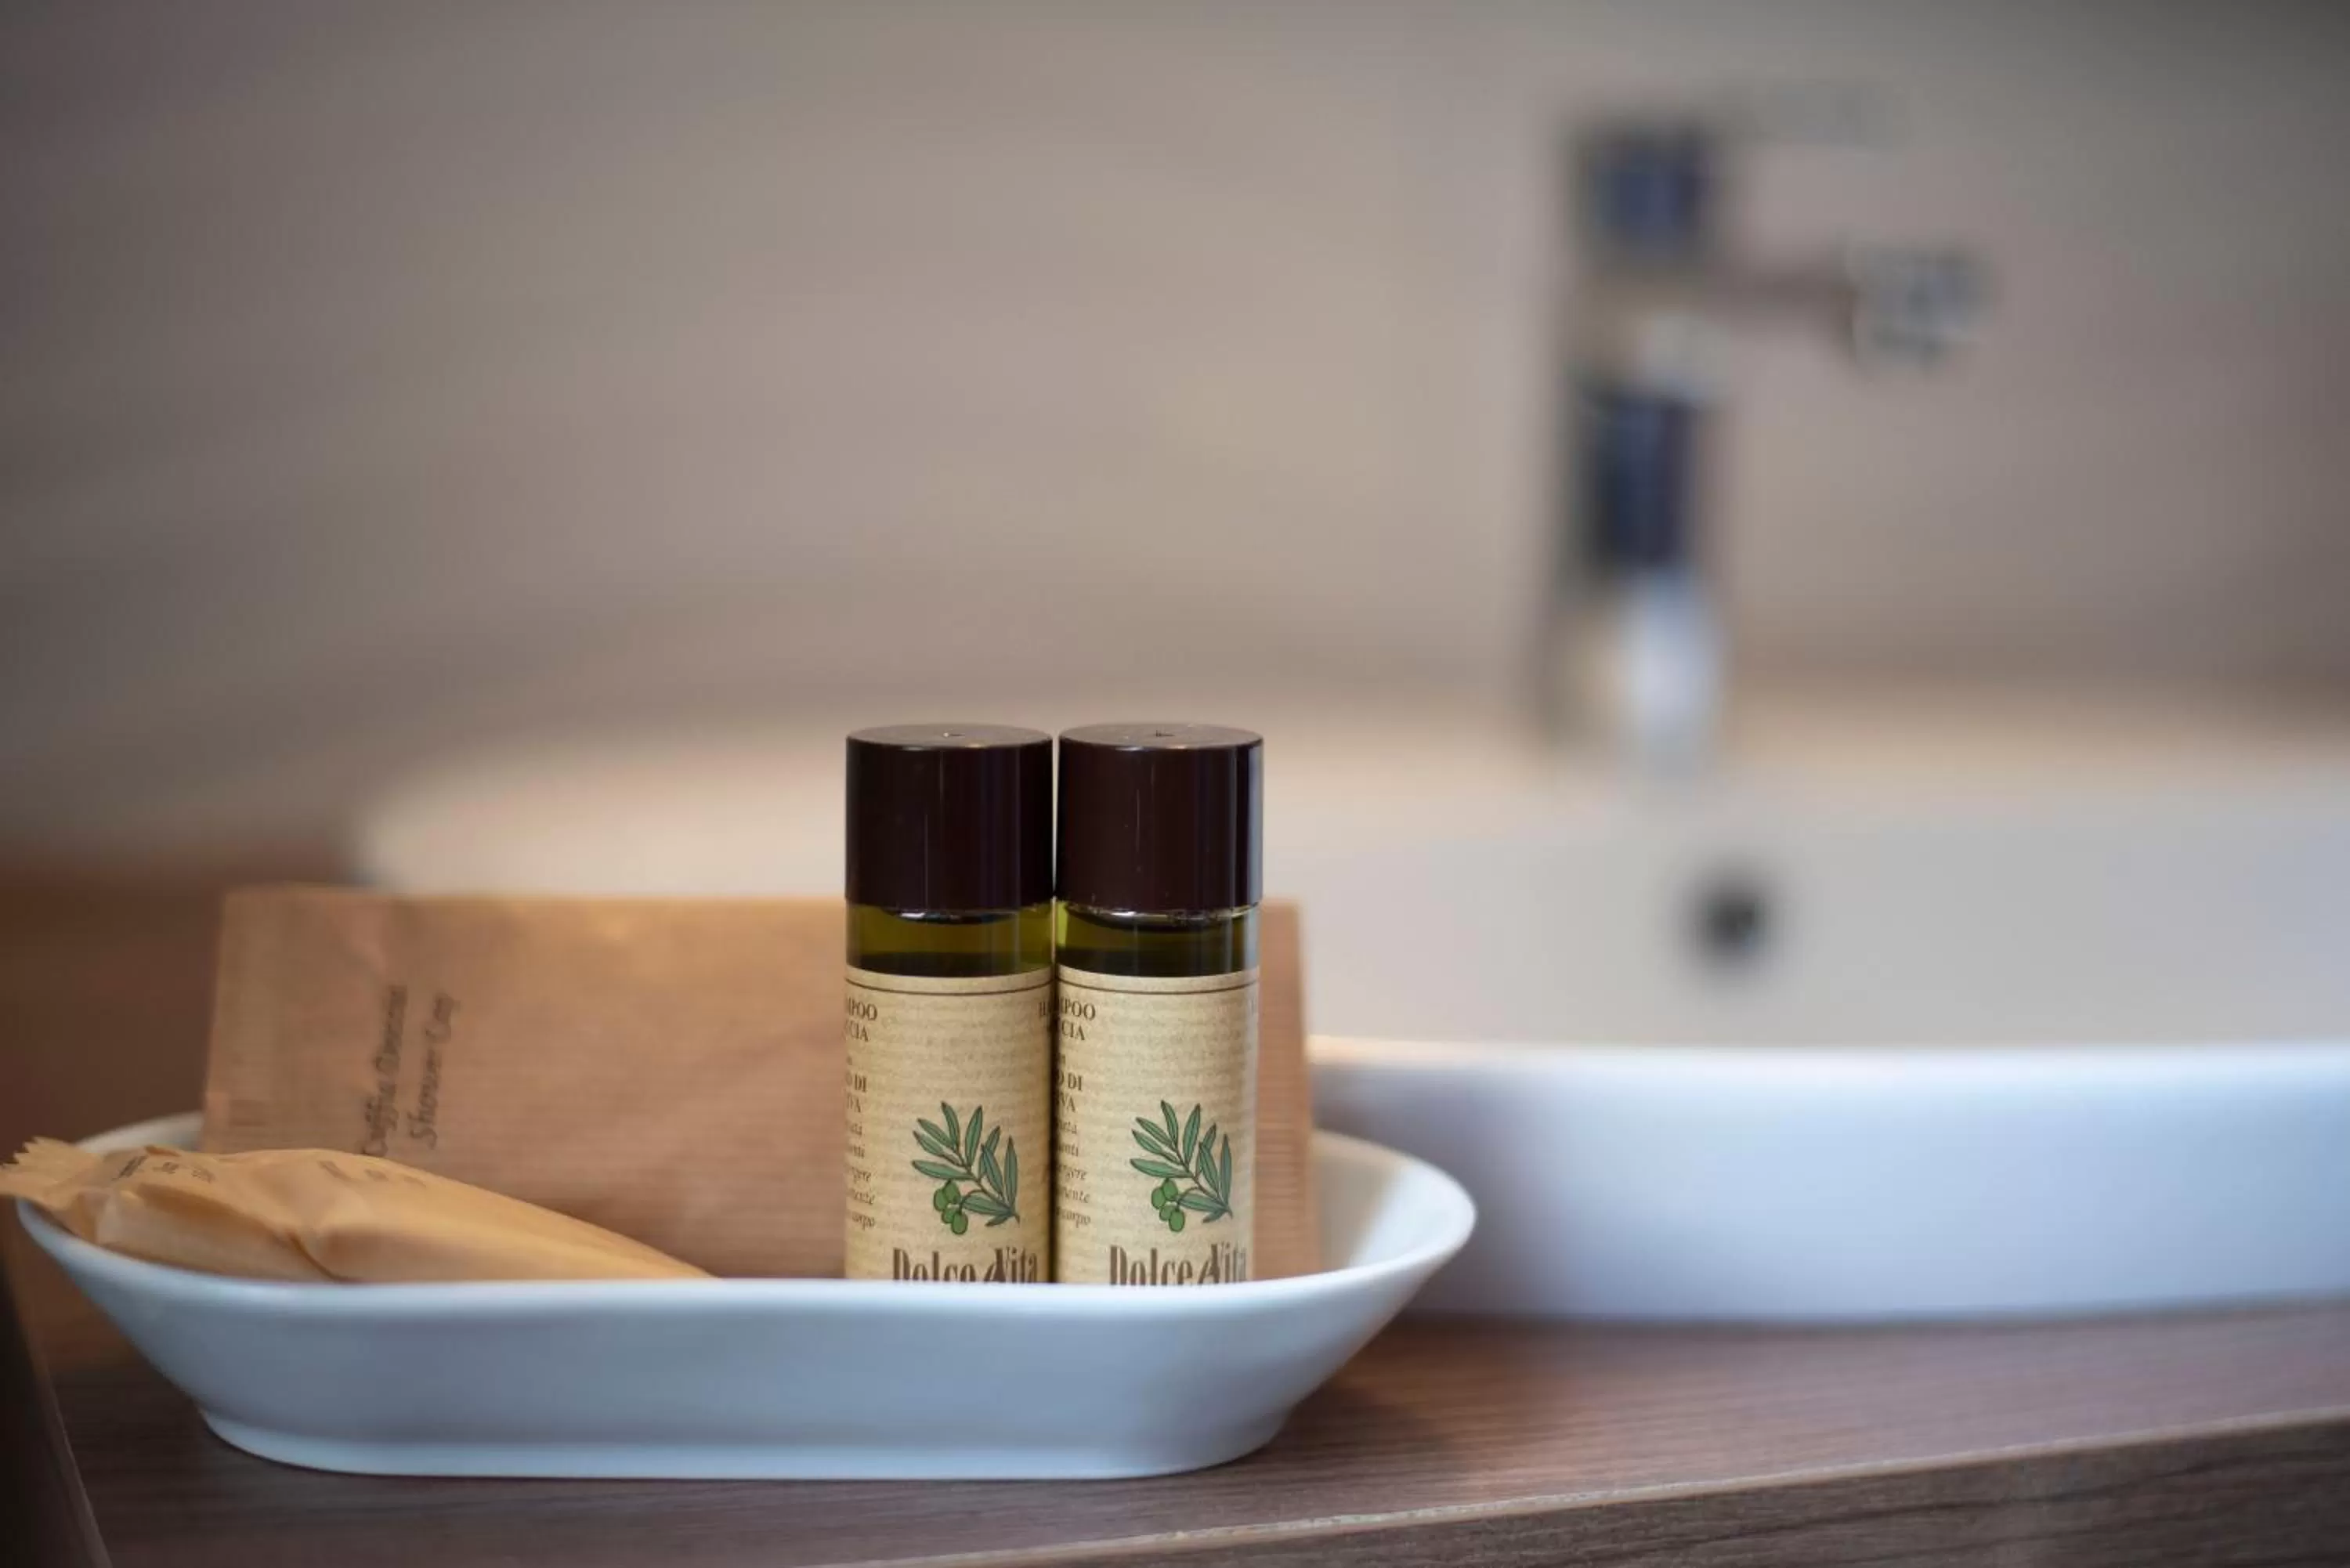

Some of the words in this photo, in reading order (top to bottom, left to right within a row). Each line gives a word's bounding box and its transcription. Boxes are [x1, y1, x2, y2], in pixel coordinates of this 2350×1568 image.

[855, 1074, 867, 1093] DI
[1068, 1072, 1083, 1091] DI
[1110, 1245, 1193, 1285] Dolce
